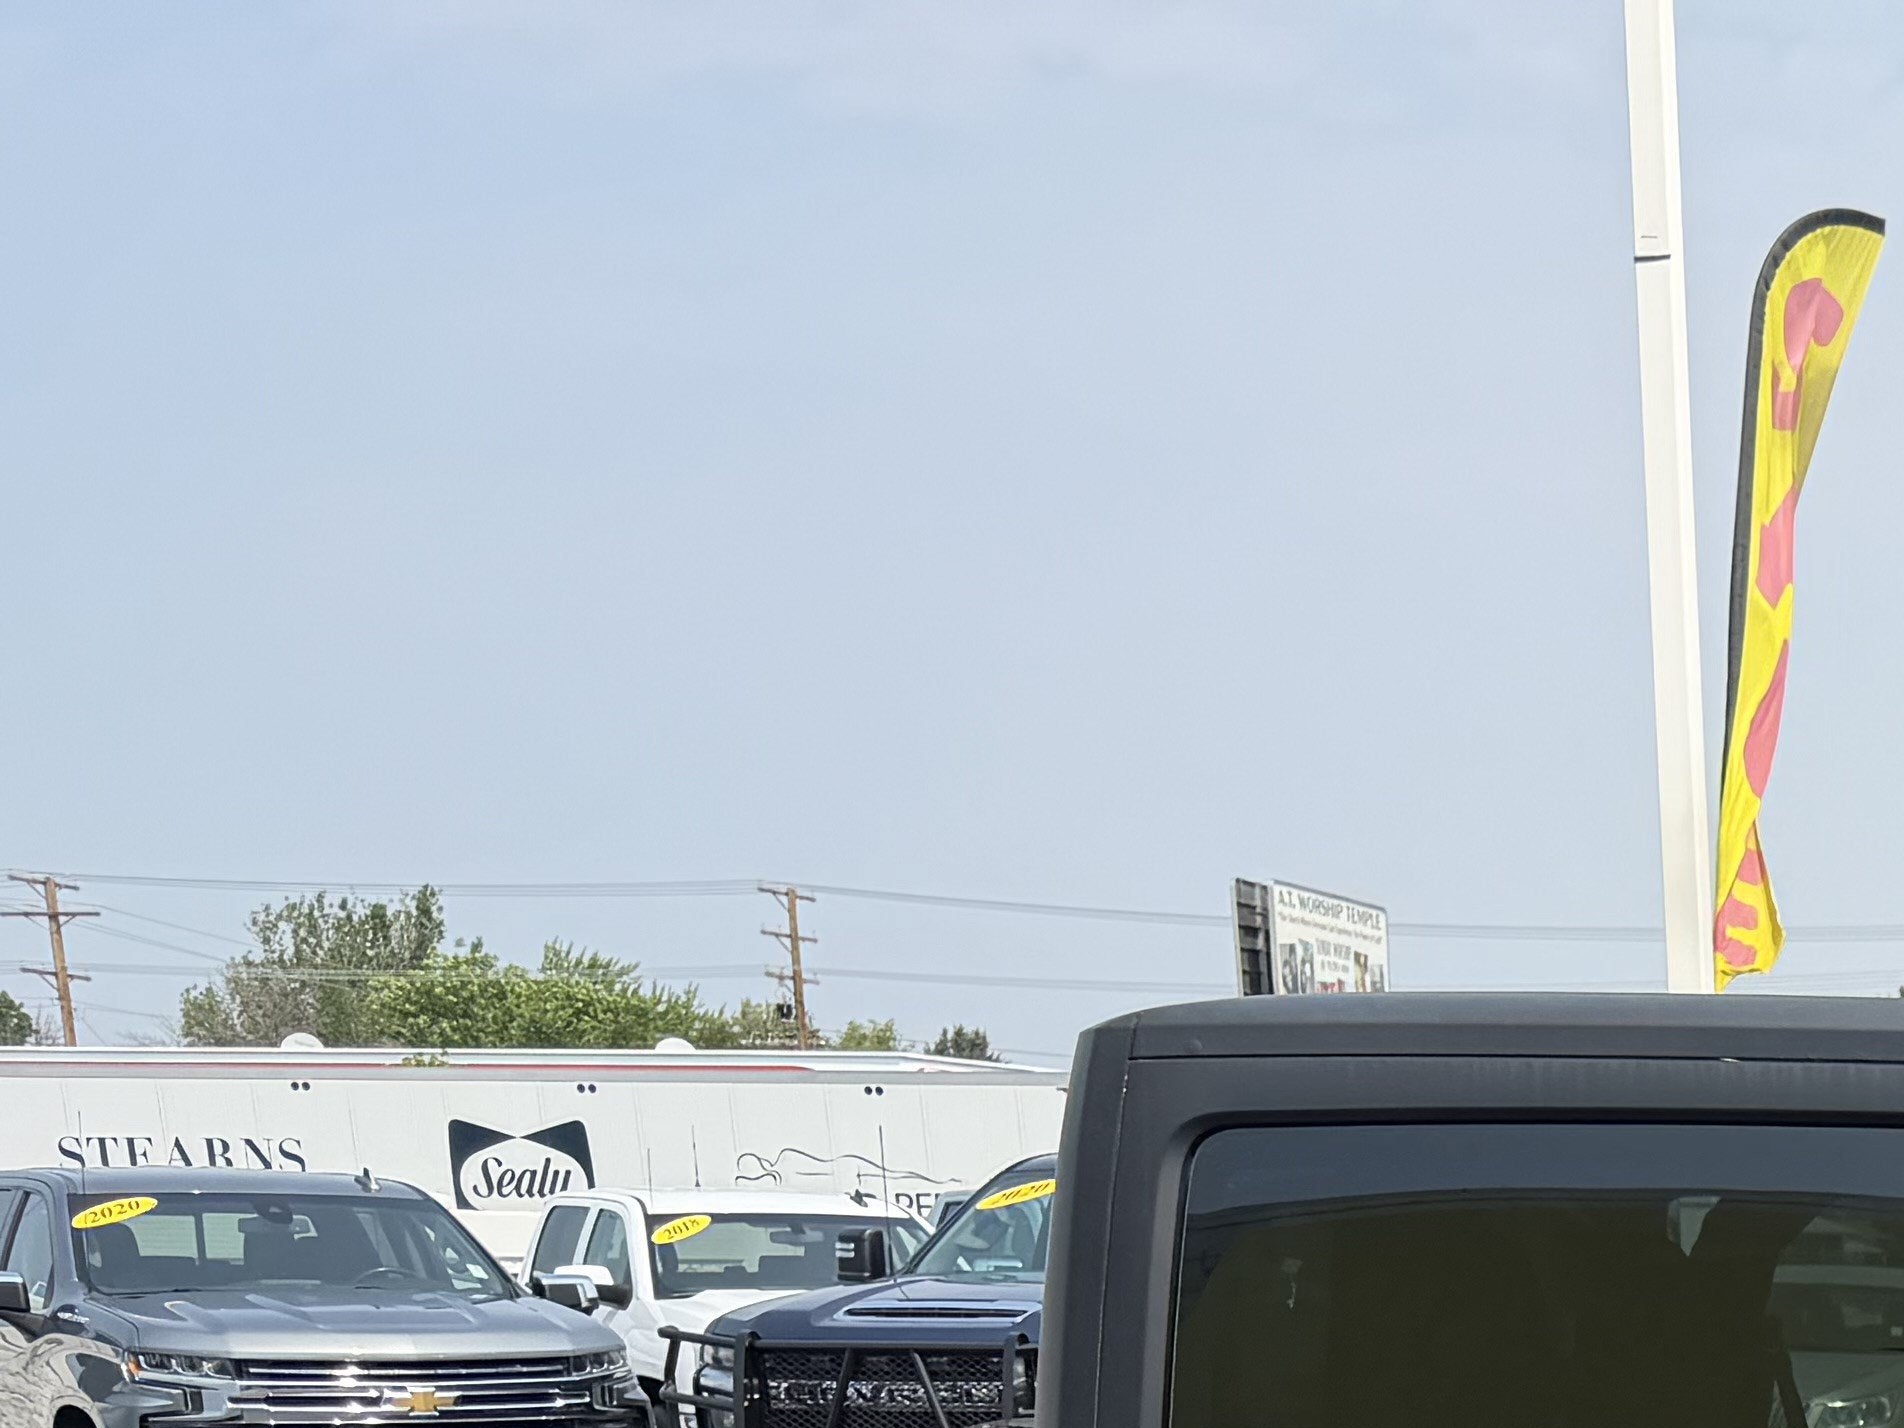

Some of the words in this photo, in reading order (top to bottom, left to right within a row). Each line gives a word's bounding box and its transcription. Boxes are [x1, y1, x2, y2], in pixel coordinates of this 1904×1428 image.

[1298, 893, 1343, 919] WORSHIP
[1346, 905, 1382, 931] TEMPLE
[57, 1135, 307, 1173] STEARNS
[89, 1199, 141, 1225] 2020
[662, 1218, 701, 1240] 2018
